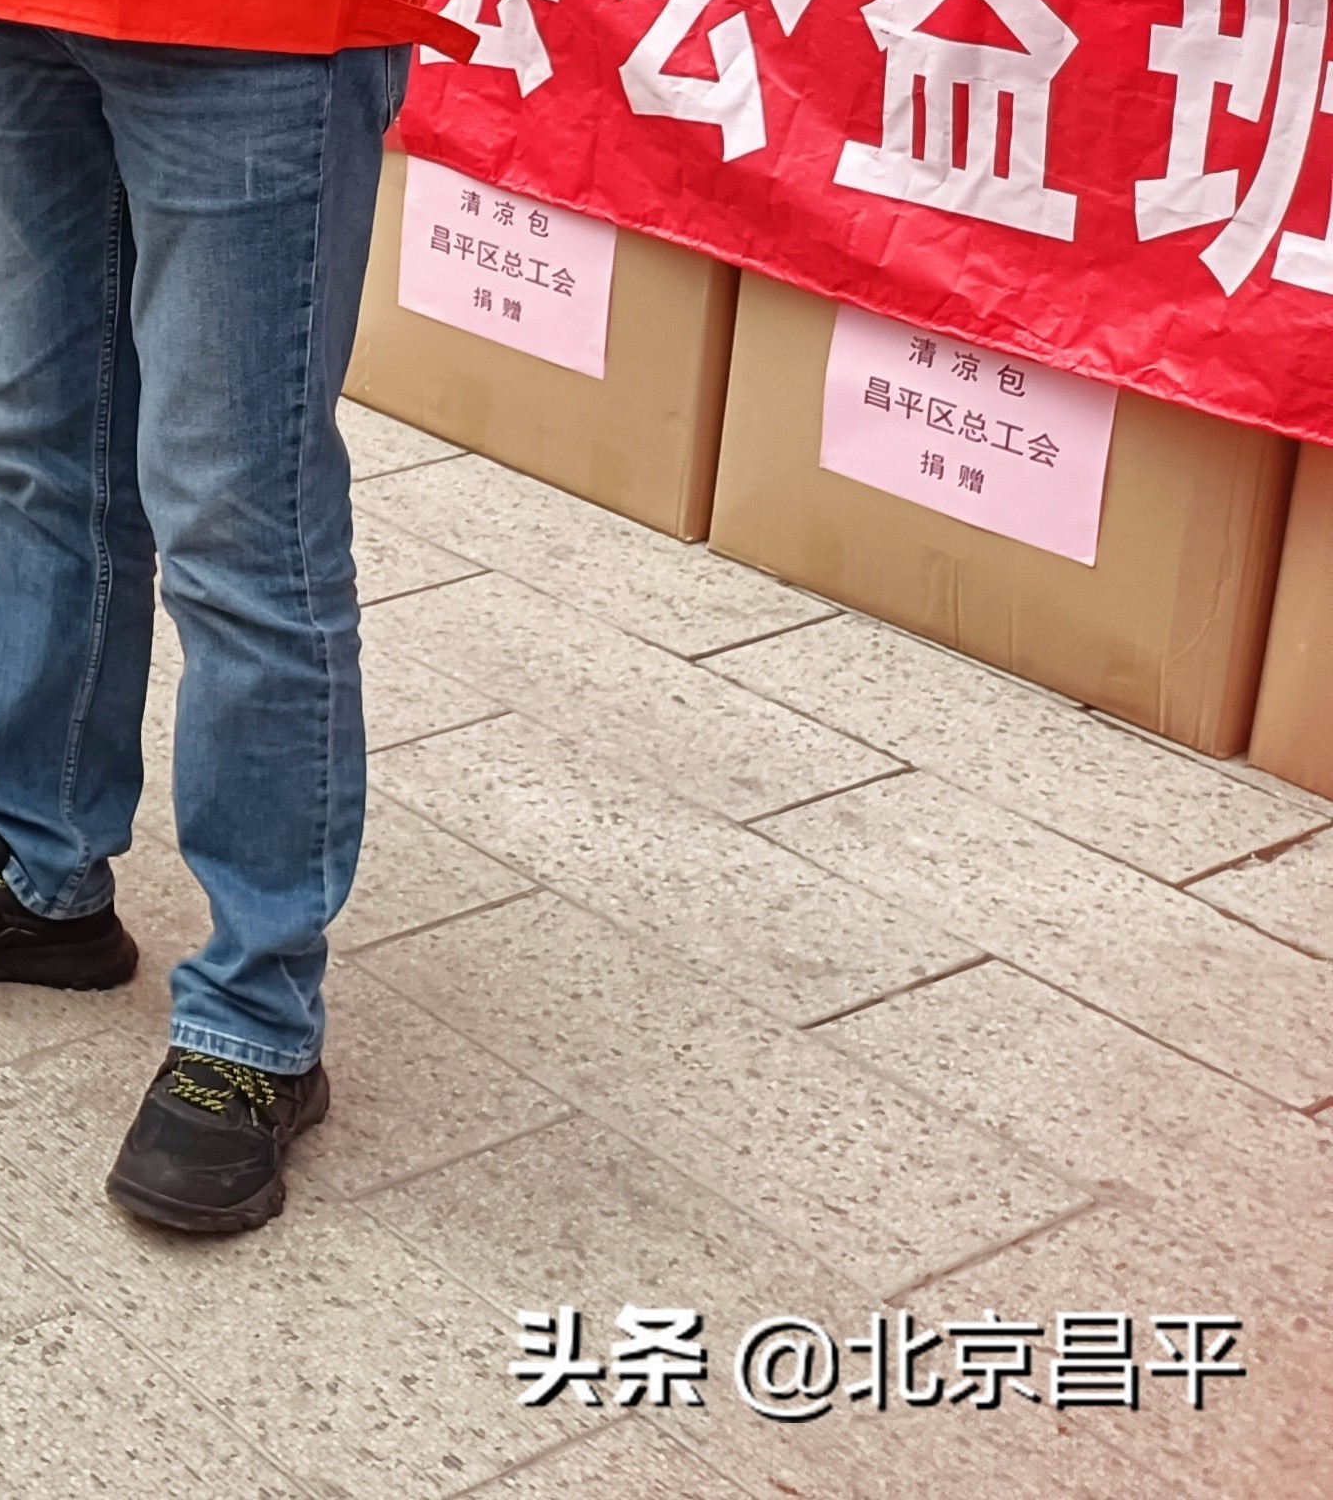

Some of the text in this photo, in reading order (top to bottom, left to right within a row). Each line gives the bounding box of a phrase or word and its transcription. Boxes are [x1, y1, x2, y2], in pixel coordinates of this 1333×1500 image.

[460, 188, 549, 238] 清凉包
[430, 224, 576, 297] 昌平区总工会
[473, 286, 522, 322] 捐赠
[908, 336, 1026, 397] 清凉包
[864, 376, 1060, 468] 昌平区总工会
[920, 450, 985, 495] 捐赠
